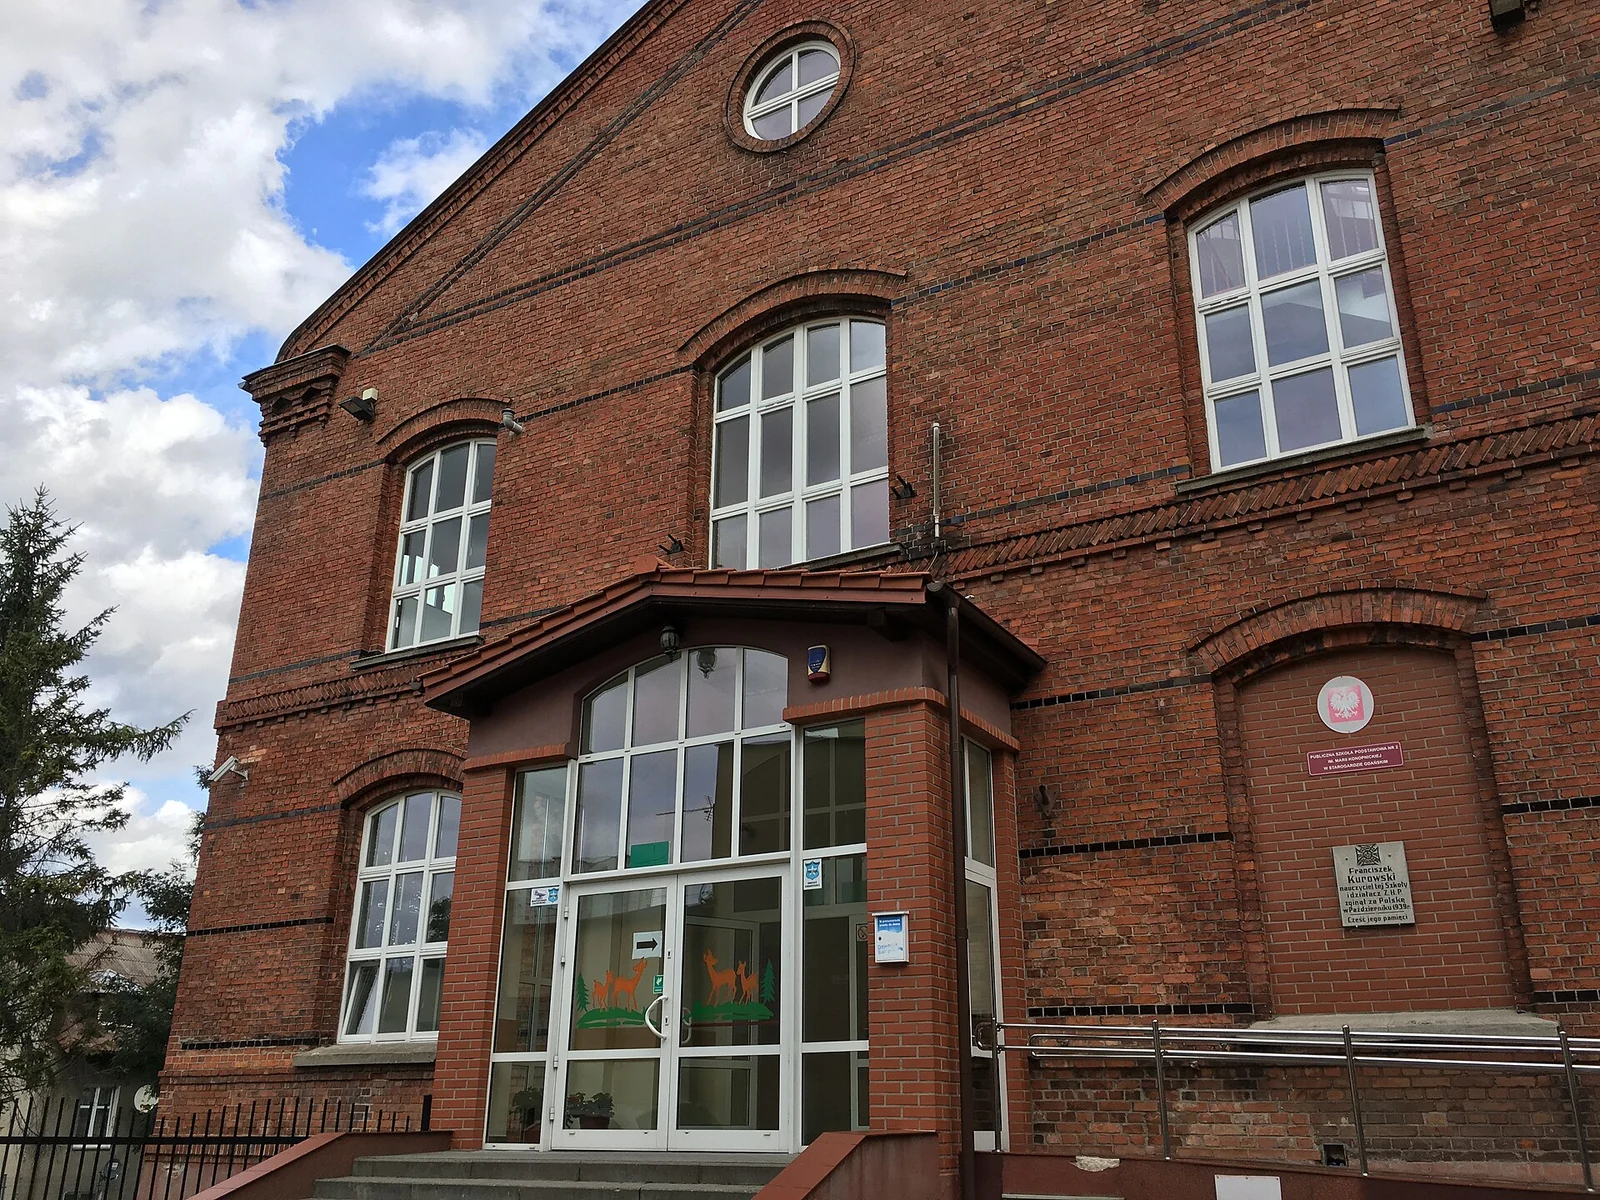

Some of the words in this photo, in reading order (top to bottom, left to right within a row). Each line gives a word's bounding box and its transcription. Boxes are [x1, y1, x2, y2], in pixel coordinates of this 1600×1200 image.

[1354, 746, 1388, 754] PODSTAWOWA
[1348, 753, 1382, 762] KONOPNICKIEJ
[1348, 866, 1392, 874] Franciszek
[1348, 872, 1396, 884] Kurowski
[1340, 884, 1374, 892] nauczyciel
